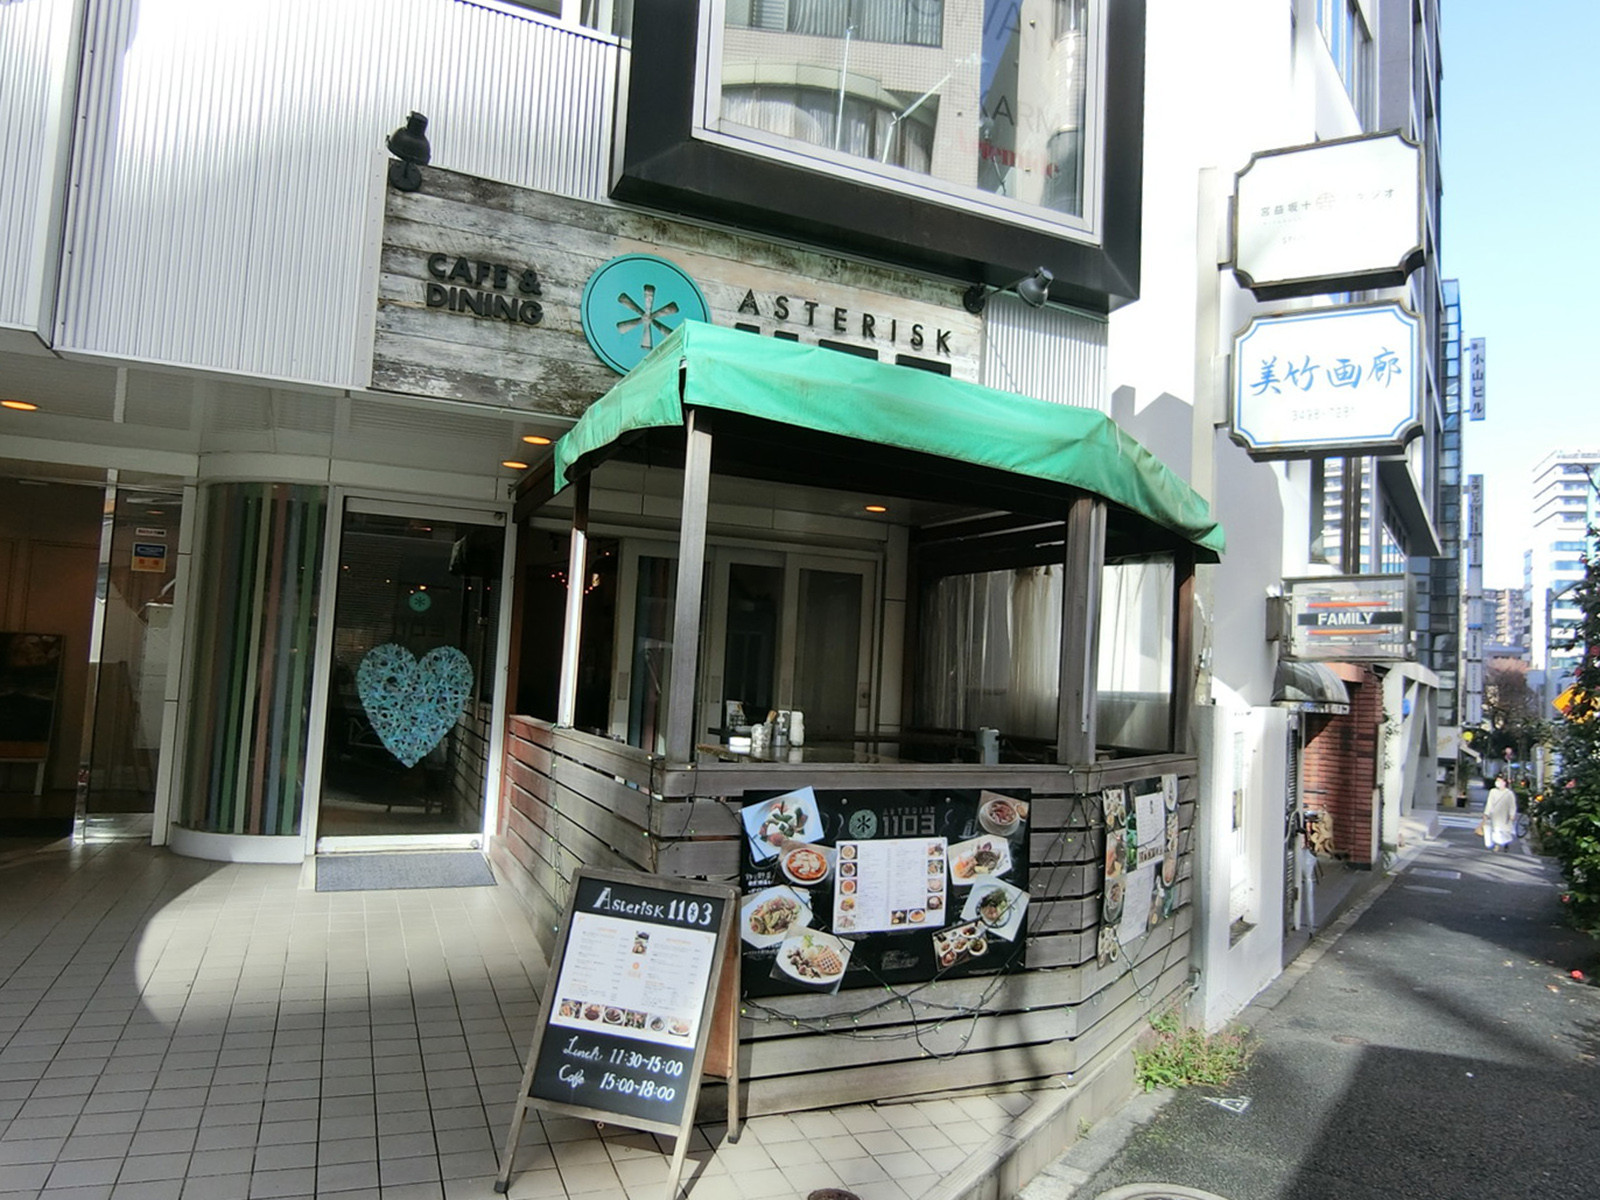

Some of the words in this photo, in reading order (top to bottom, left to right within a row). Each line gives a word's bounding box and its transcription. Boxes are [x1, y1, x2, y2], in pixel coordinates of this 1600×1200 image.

[427, 252, 508, 290] CAFE
[518, 268, 542, 296] &
[426, 282, 544, 325] DINING
[737, 288, 952, 355] ASTERISK
[1249, 346, 1402, 396] 美竹画廊
[1317, 612, 1374, 626] FAMILY
[882, 814, 936, 836] 1103
[593, 887, 665, 918] Asterisk
[668, 899, 713, 926] 1103
[562, 1035, 604, 1060] Lunch
